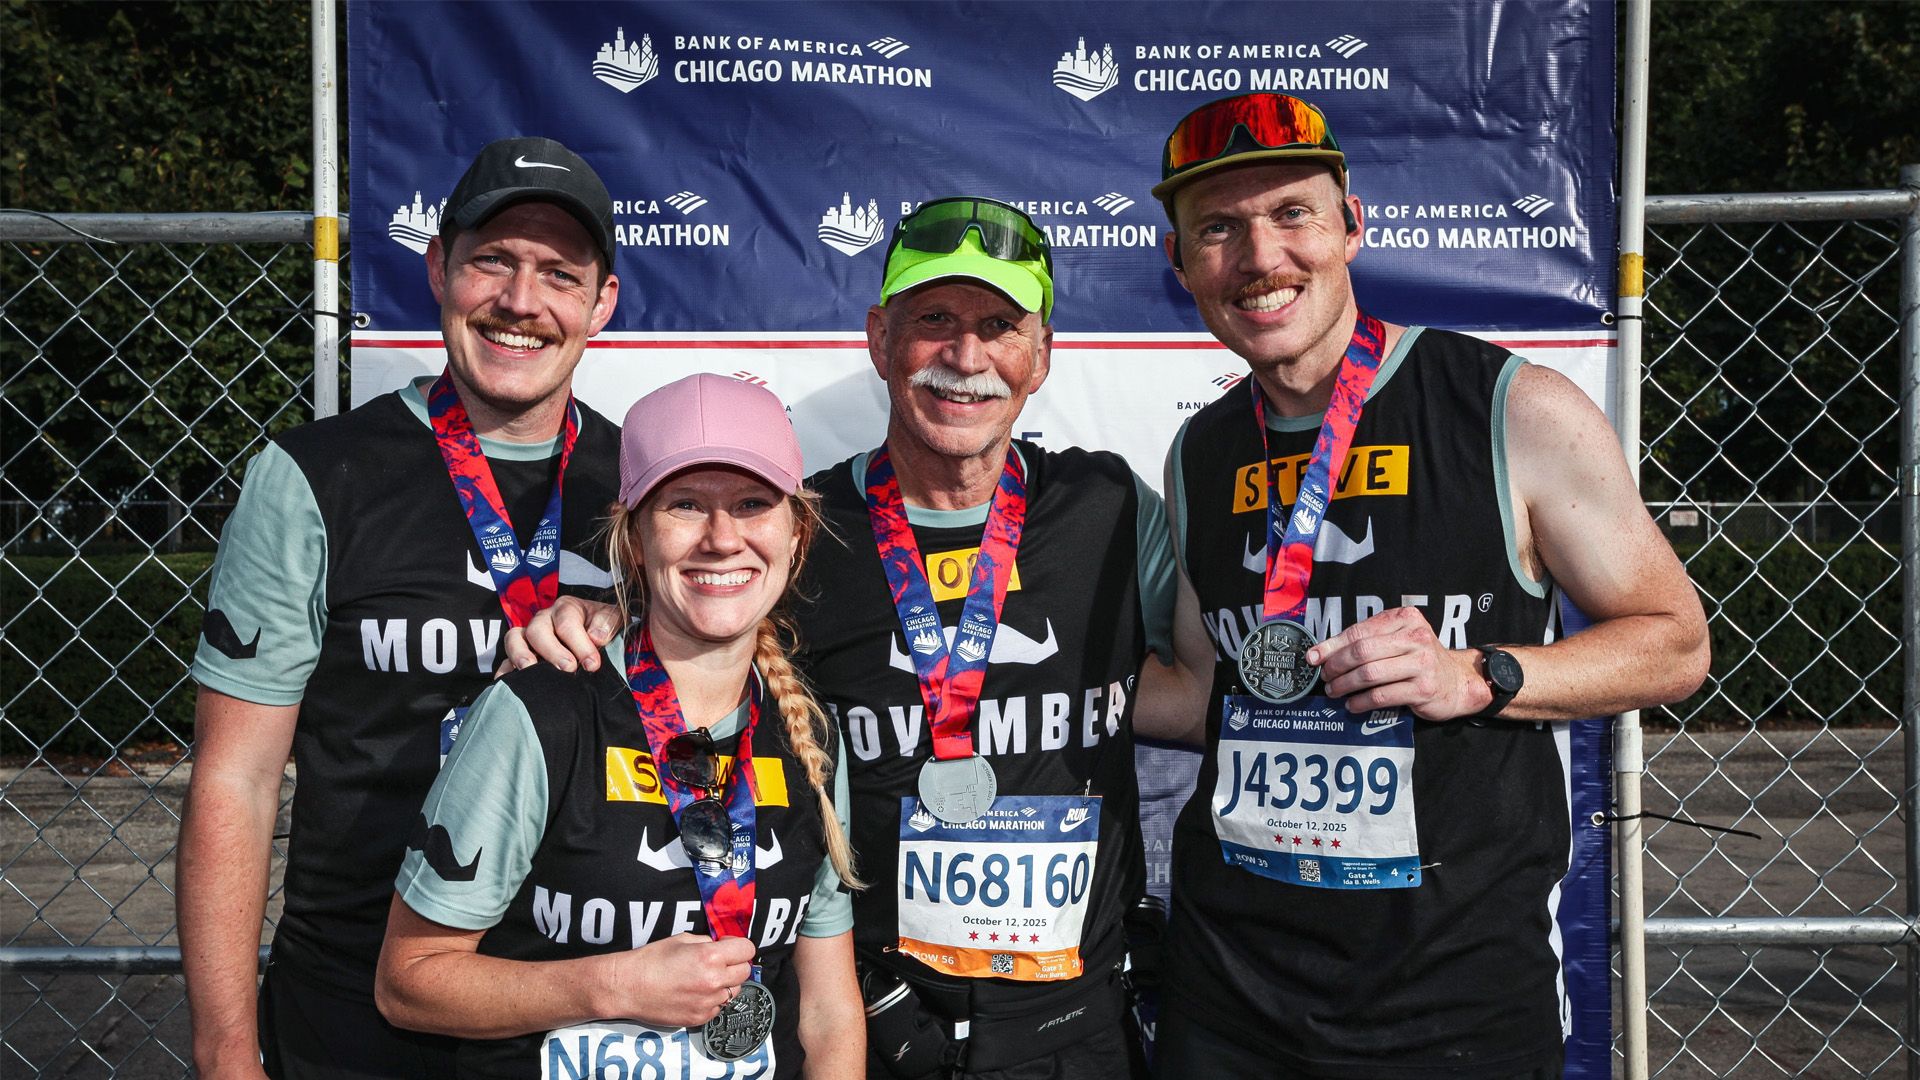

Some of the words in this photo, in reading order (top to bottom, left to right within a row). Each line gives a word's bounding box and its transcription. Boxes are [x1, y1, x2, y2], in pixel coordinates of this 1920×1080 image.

[674, 36, 731, 50] BANK
[736, 36, 764, 50] OF
[768, 38, 864, 56] AMERICA
[1135, 45, 1191, 59] BANK
[1197, 44, 1224, 59] OF
[1228, 44, 1321, 59] AMERICA
[674, 60, 783, 83] CHICAGO
[791, 61, 932, 88] MARATHON
[1134, 68, 1242, 91] CHICAGO
[1250, 68, 1389, 91] MARATHON
[613, 200, 660, 215] RICA
[1010, 201, 1089, 215] MERICA
[1384, 204, 1410, 219] OF
[1415, 204, 1508, 219] AMERICA
[615, 223, 729, 247] ARATHON
[1042, 224, 1156, 248] ARATHON
[1437, 226, 1576, 249] MARATHON
[482, 534, 512, 546] CHICAGO
[905, 615, 936, 627] CHICAGO
[907, 621, 937, 631] MARATHON
[961, 628, 992, 640] MARATHON
[963, 622, 993, 635] CHICAGO
[1285, 710, 1320, 718] AMERICA
[1370, 711, 1400, 725] RUN
[1252, 718, 1291, 729] CHICAGO
[1292, 720, 1344, 732] MARATHON
[1219, 750, 1399, 818] J43399
[1066, 807, 1089, 821] RUN
[989, 820, 1045, 831] MARATHON
[1267, 818, 1303, 830] October
[1306, 821, 1320, 832] 12,
[1323, 822, 1348, 832] 2025
[1236, 853, 1256, 865] ROW
[904, 850, 1091, 909] N68160
[1391, 868, 1399, 877] 4
[962, 915, 1002, 927] October
[1005, 918, 1020, 928] 12,
[1023, 918, 1047, 928] 2025
[941, 955, 955, 965] 56
